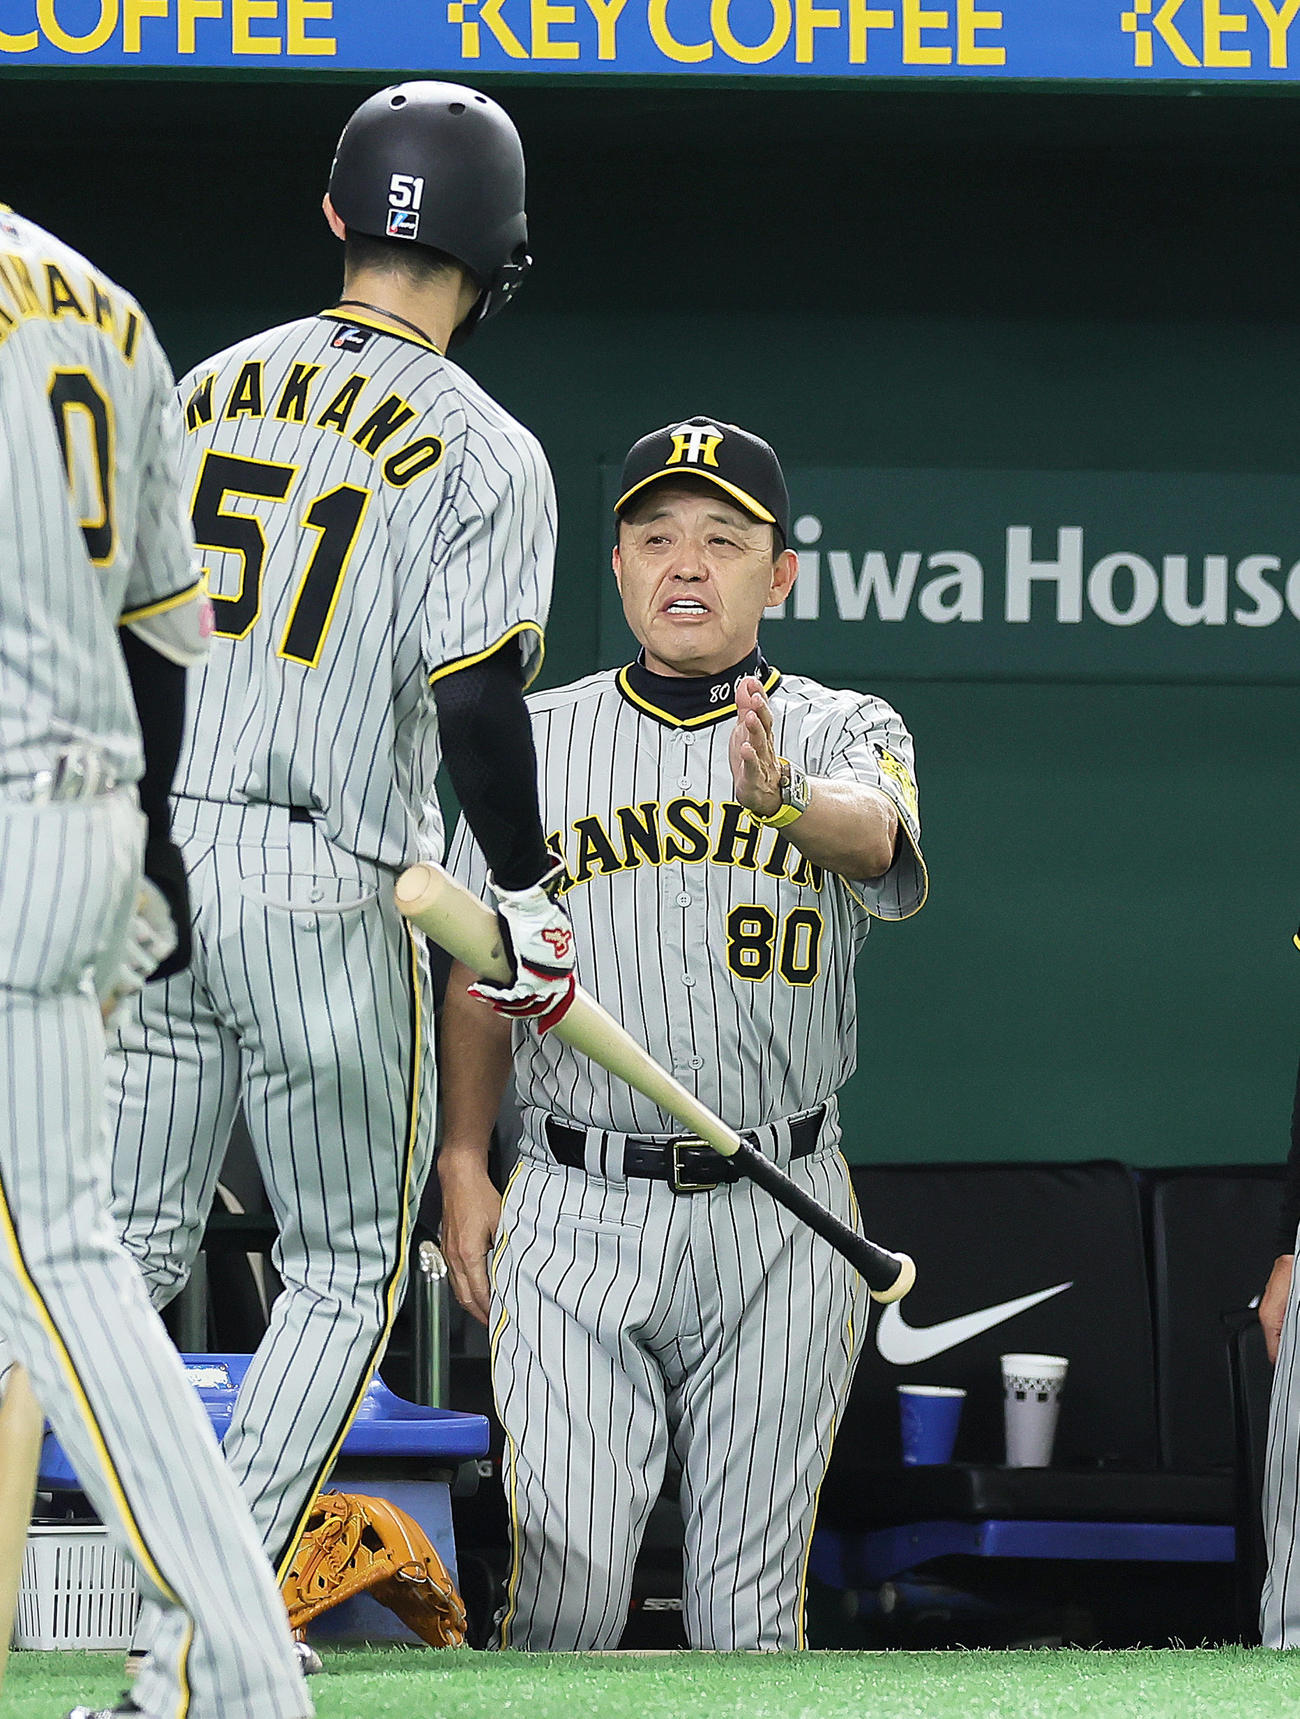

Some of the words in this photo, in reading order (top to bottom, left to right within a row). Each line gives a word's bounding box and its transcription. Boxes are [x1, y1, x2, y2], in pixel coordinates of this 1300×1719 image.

[1121, 0, 1300, 68] KEY
[388, 173, 425, 210] 51
[184, 360, 446, 489] NAKANO
[189, 448, 374, 669] 51
[762, 515, 985, 623] iwa
[1004, 525, 1300, 627] Hous
[709, 682, 731, 703] 80
[725, 903, 825, 987] 80
